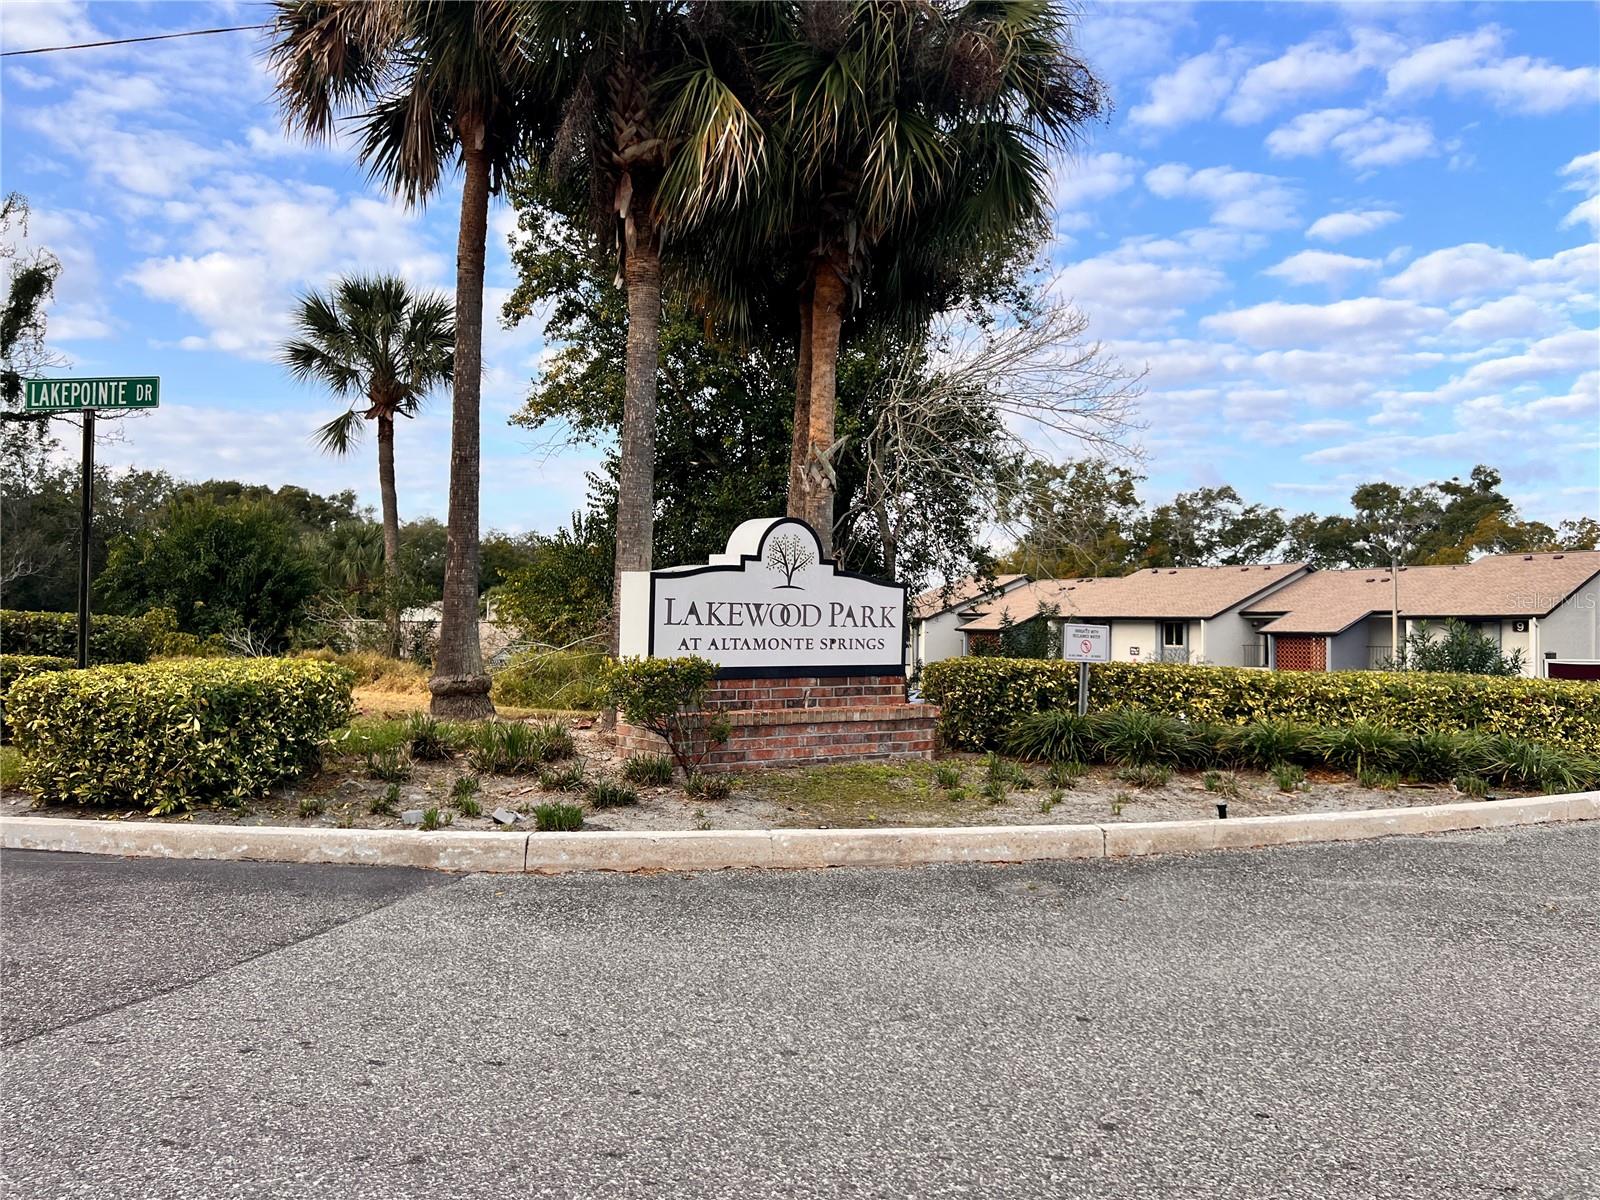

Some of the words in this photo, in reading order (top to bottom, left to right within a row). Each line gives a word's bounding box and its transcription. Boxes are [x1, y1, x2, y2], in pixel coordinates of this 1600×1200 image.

[31, 381, 127, 406] LAKEPOINTE
[136, 384, 153, 401] DR
[664, 598, 822, 627] LAKEWOOD
[828, 602, 897, 628] PARK
[1516, 622, 1525, 632] 9
[678, 637, 702, 650] AT
[708, 637, 814, 650] ALTAMONTE
[820, 637, 885, 650] SPRINGS
